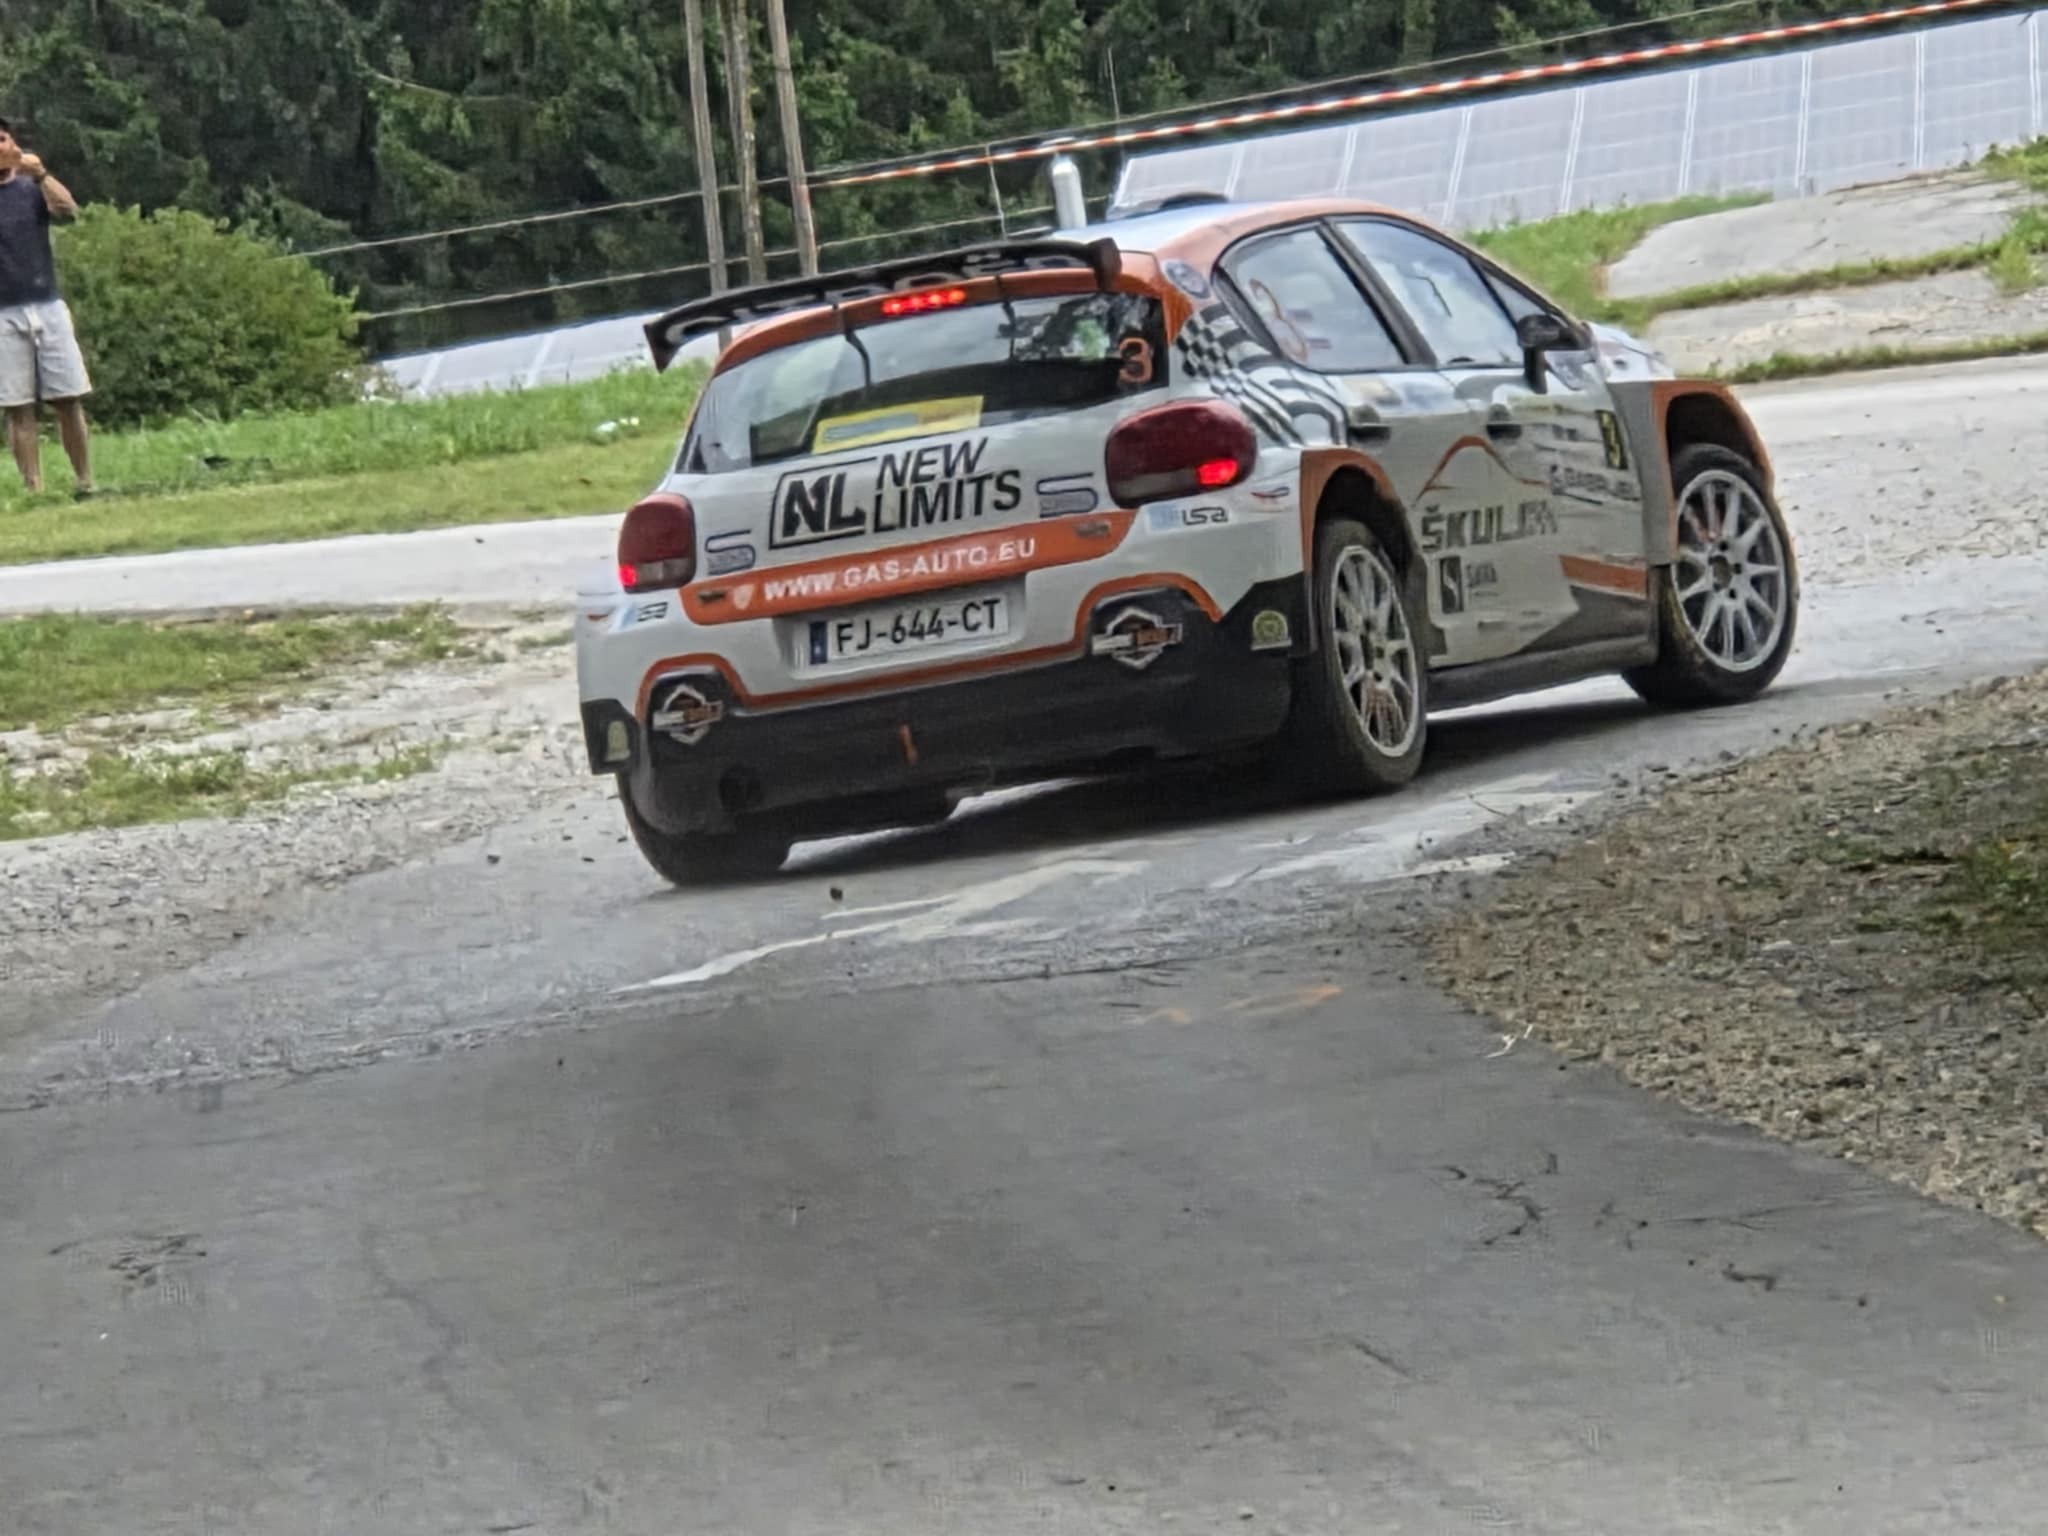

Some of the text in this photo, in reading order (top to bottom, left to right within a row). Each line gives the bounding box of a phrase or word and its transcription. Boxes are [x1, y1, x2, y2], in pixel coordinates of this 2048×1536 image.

[1118, 337, 1153, 384] 3
[877, 437, 989, 490] NEW
[782, 472, 867, 538] NL
[874, 470, 1022, 534] LIMITS
[837, 599, 1001, 653] FJ-644-CT
